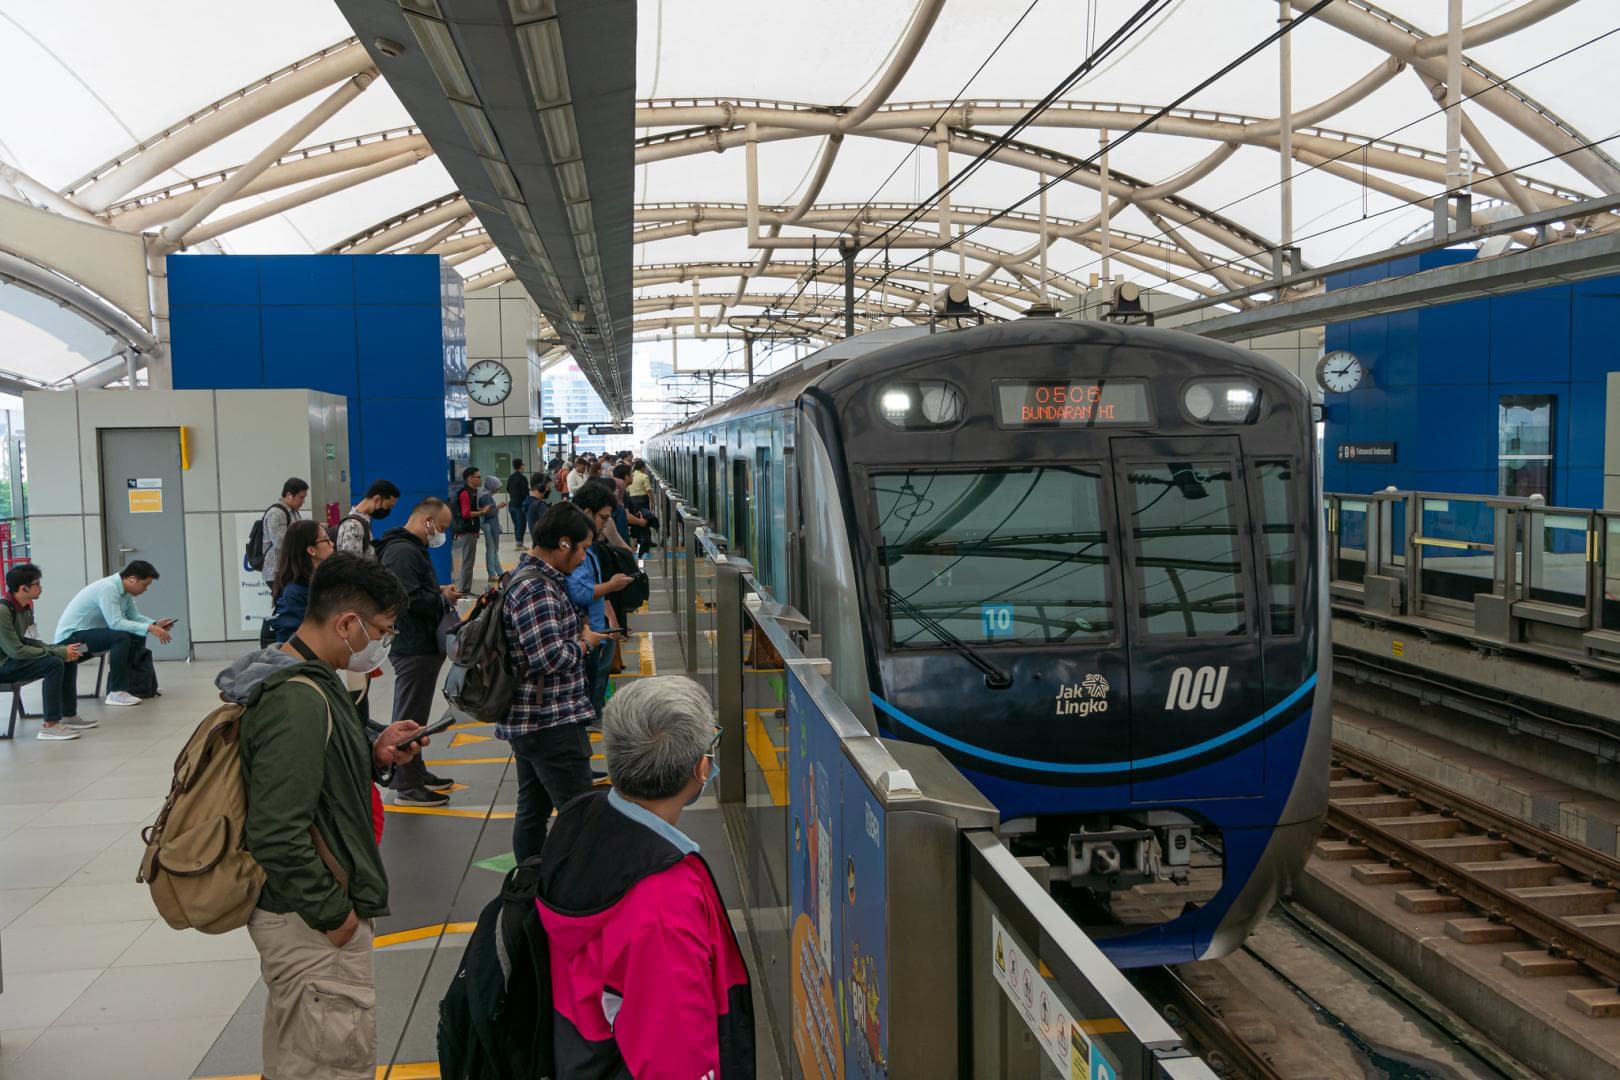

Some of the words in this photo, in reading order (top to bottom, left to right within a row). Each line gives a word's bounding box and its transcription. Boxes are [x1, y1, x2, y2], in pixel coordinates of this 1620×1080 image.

[1036, 386, 1101, 403] 0506
[1021, 405, 1092, 421] BUNDARAN
[1099, 404, 1116, 420] HI
[984, 608, 1011, 631] 10
[1056, 684, 1083, 700] Jak
[1056, 700, 1108, 717] Lingko
[852, 980, 867, 1033] BRI
